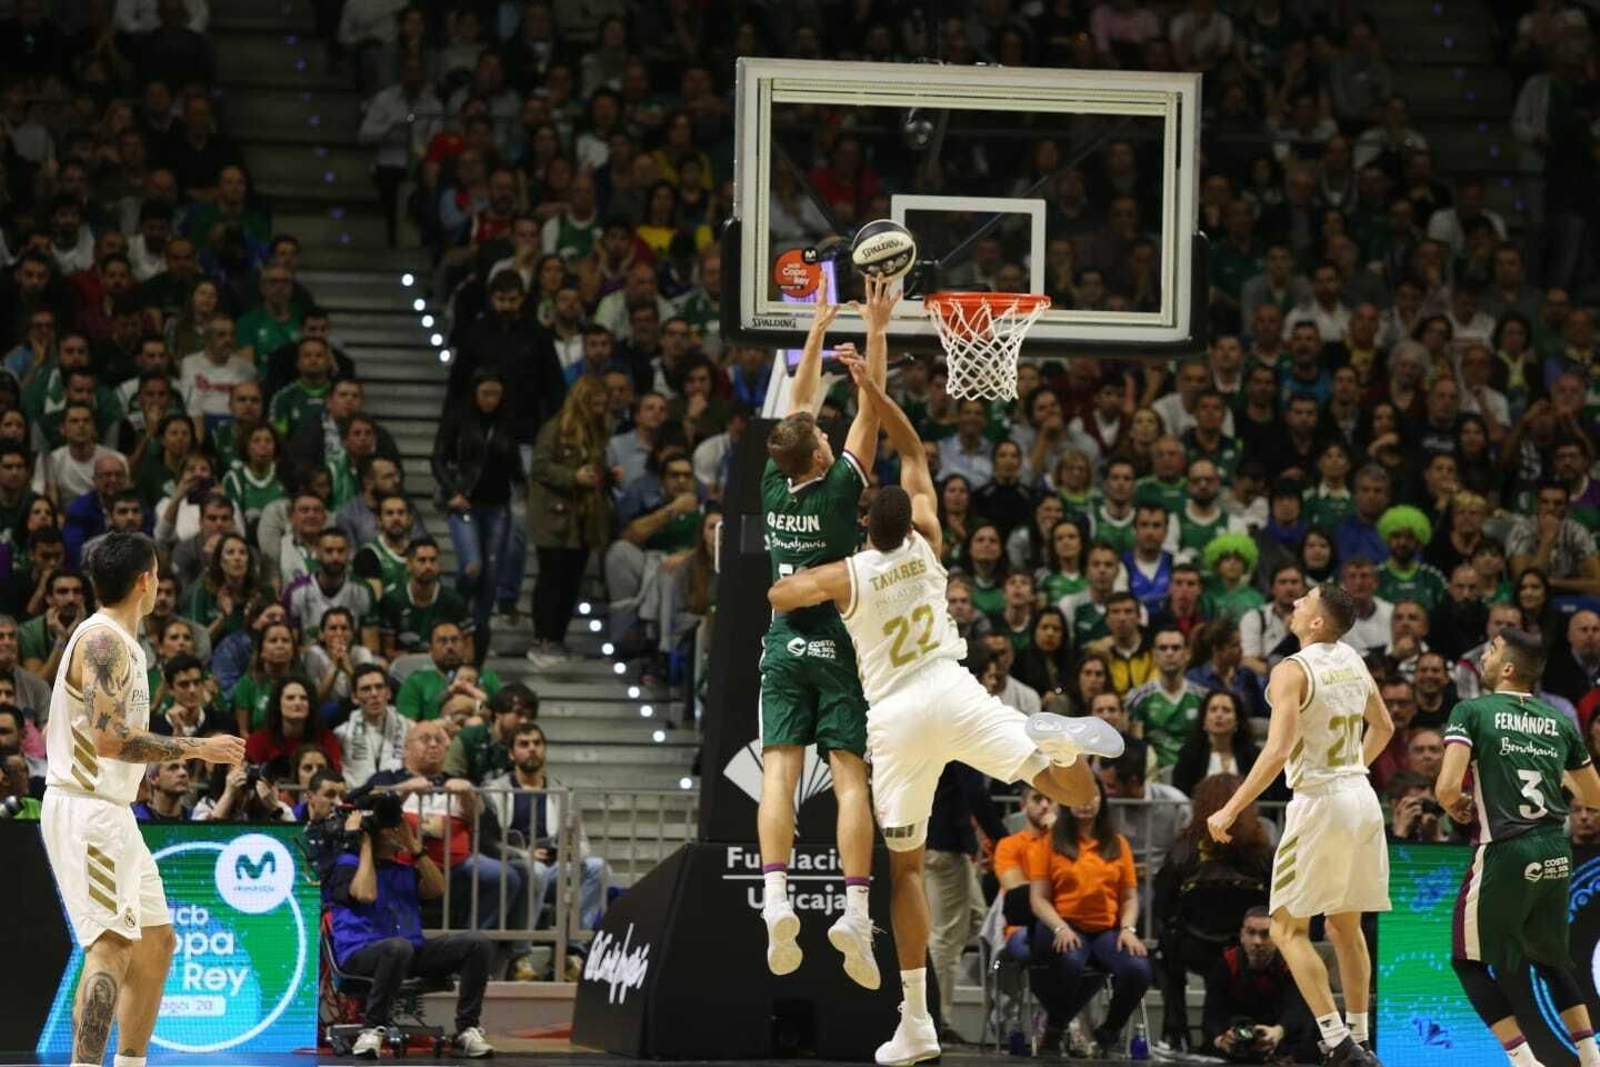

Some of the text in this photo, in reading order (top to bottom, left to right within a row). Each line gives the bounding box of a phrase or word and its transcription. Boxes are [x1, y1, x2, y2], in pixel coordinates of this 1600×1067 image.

[752, 317, 797, 329] SPALDING
[767, 511, 820, 532] GERUN
[870, 559, 927, 591] TAVARES
[882, 604, 941, 668] 22
[1495, 711, 1560, 737] FERNÁNDEZ
[1517, 768, 1548, 820] 3
[1544, 856, 1569, 868] COSTA
[747, 883, 848, 916] Uicaja
[183, 961, 249, 997] Rey
